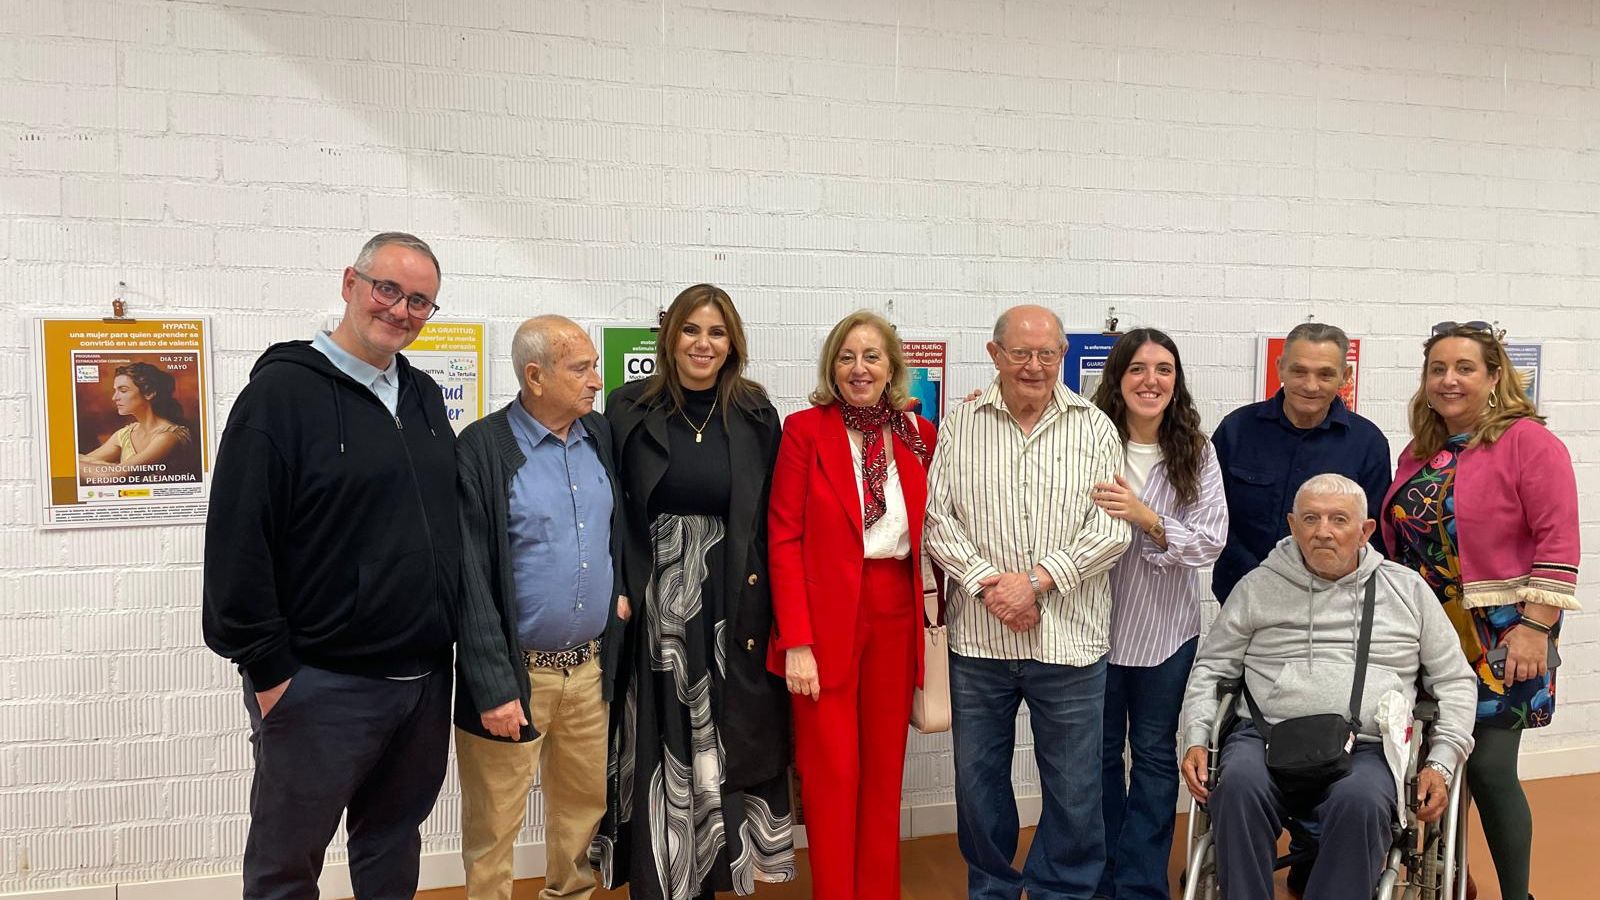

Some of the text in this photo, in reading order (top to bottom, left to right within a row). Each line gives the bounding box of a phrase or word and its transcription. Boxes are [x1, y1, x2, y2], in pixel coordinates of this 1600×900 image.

[95, 464, 166, 473] CONOCIMIENTO
[86, 476, 126, 484] PERDIDO
[142, 472, 196, 482] ALEJANDRÍA
